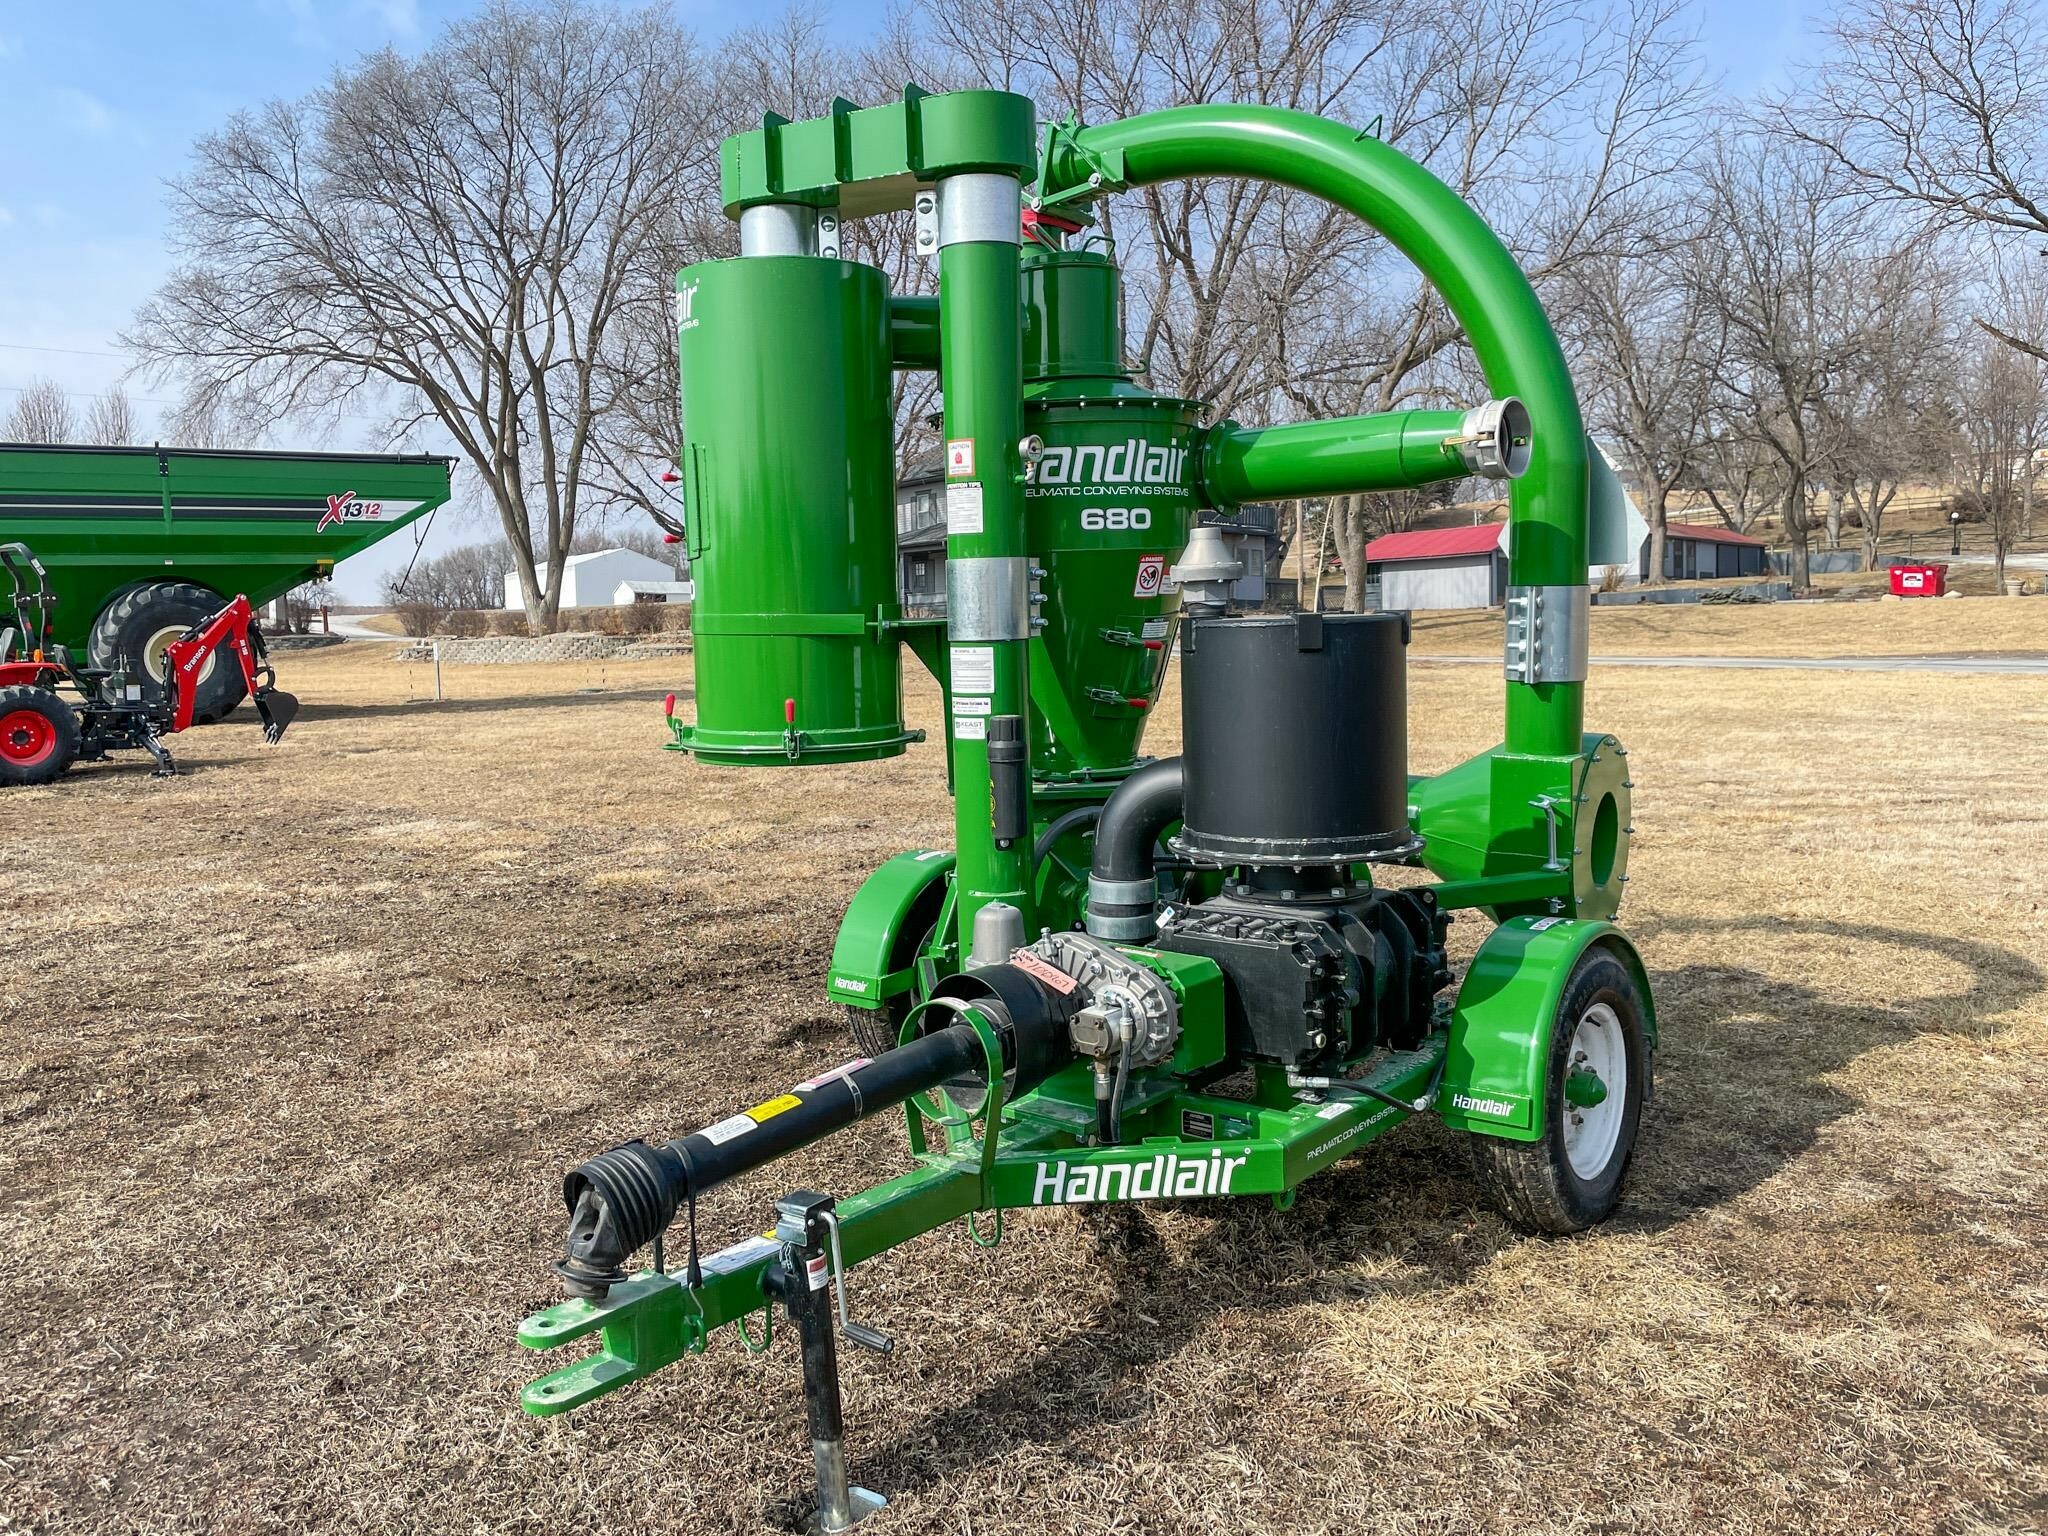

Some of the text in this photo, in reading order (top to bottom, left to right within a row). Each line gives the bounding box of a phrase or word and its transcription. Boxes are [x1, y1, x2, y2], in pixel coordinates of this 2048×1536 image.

[1083, 486, 1152, 496] CONVEYING
[1153, 486, 1189, 497] SYSTEMS
[1080, 508, 1151, 530] 680
[184, 644, 207, 672] Branson
[835, 975, 868, 993] Handlair
[1452, 1093, 1515, 1117] Handlair
[1307, 1134, 1342, 1160] PNEUMATIC
[1342, 1114, 1378, 1140] CONVEYING
[1033, 1148, 1247, 1205] Handlair
